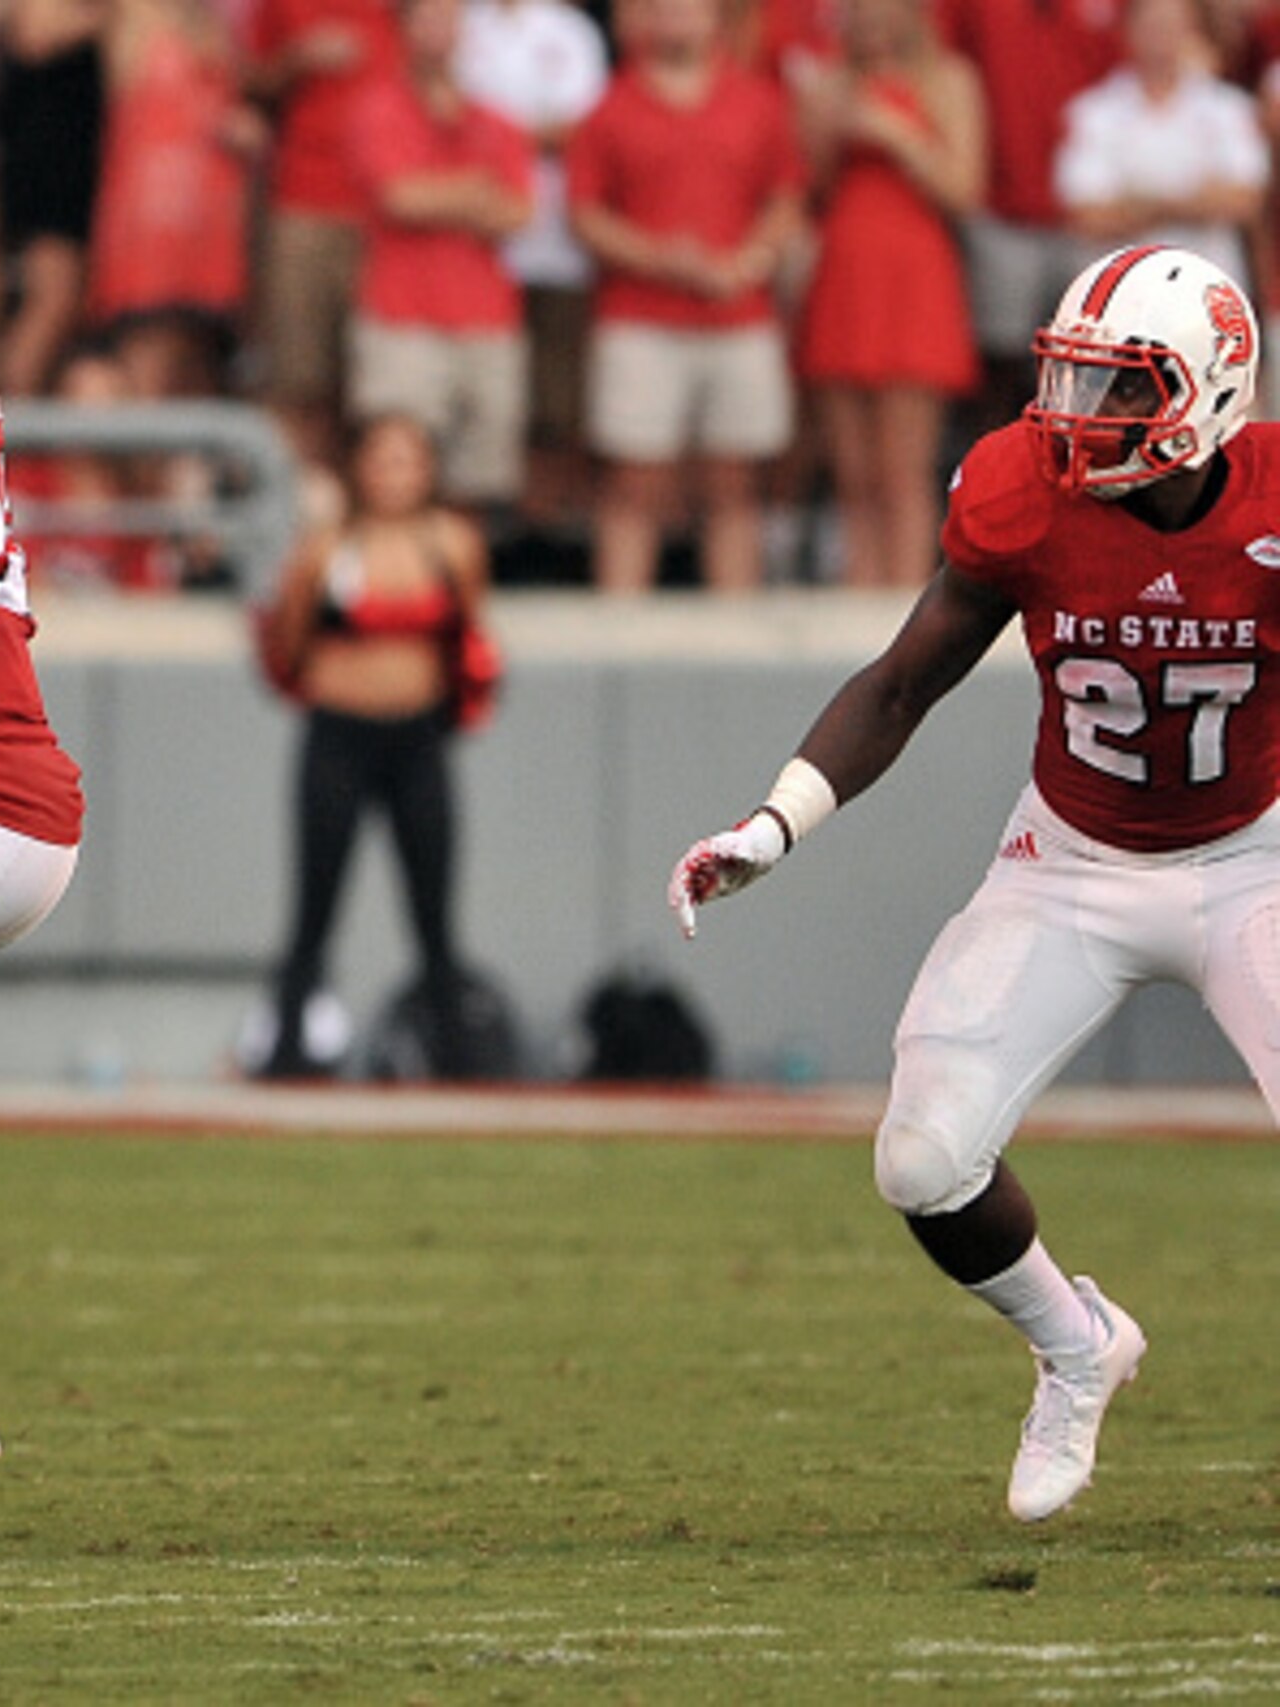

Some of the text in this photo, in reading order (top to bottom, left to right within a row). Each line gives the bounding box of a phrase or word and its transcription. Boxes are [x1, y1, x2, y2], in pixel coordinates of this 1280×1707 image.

[1054, 611, 1257, 648] NC STATE
[1053, 656, 1258, 784] 27
